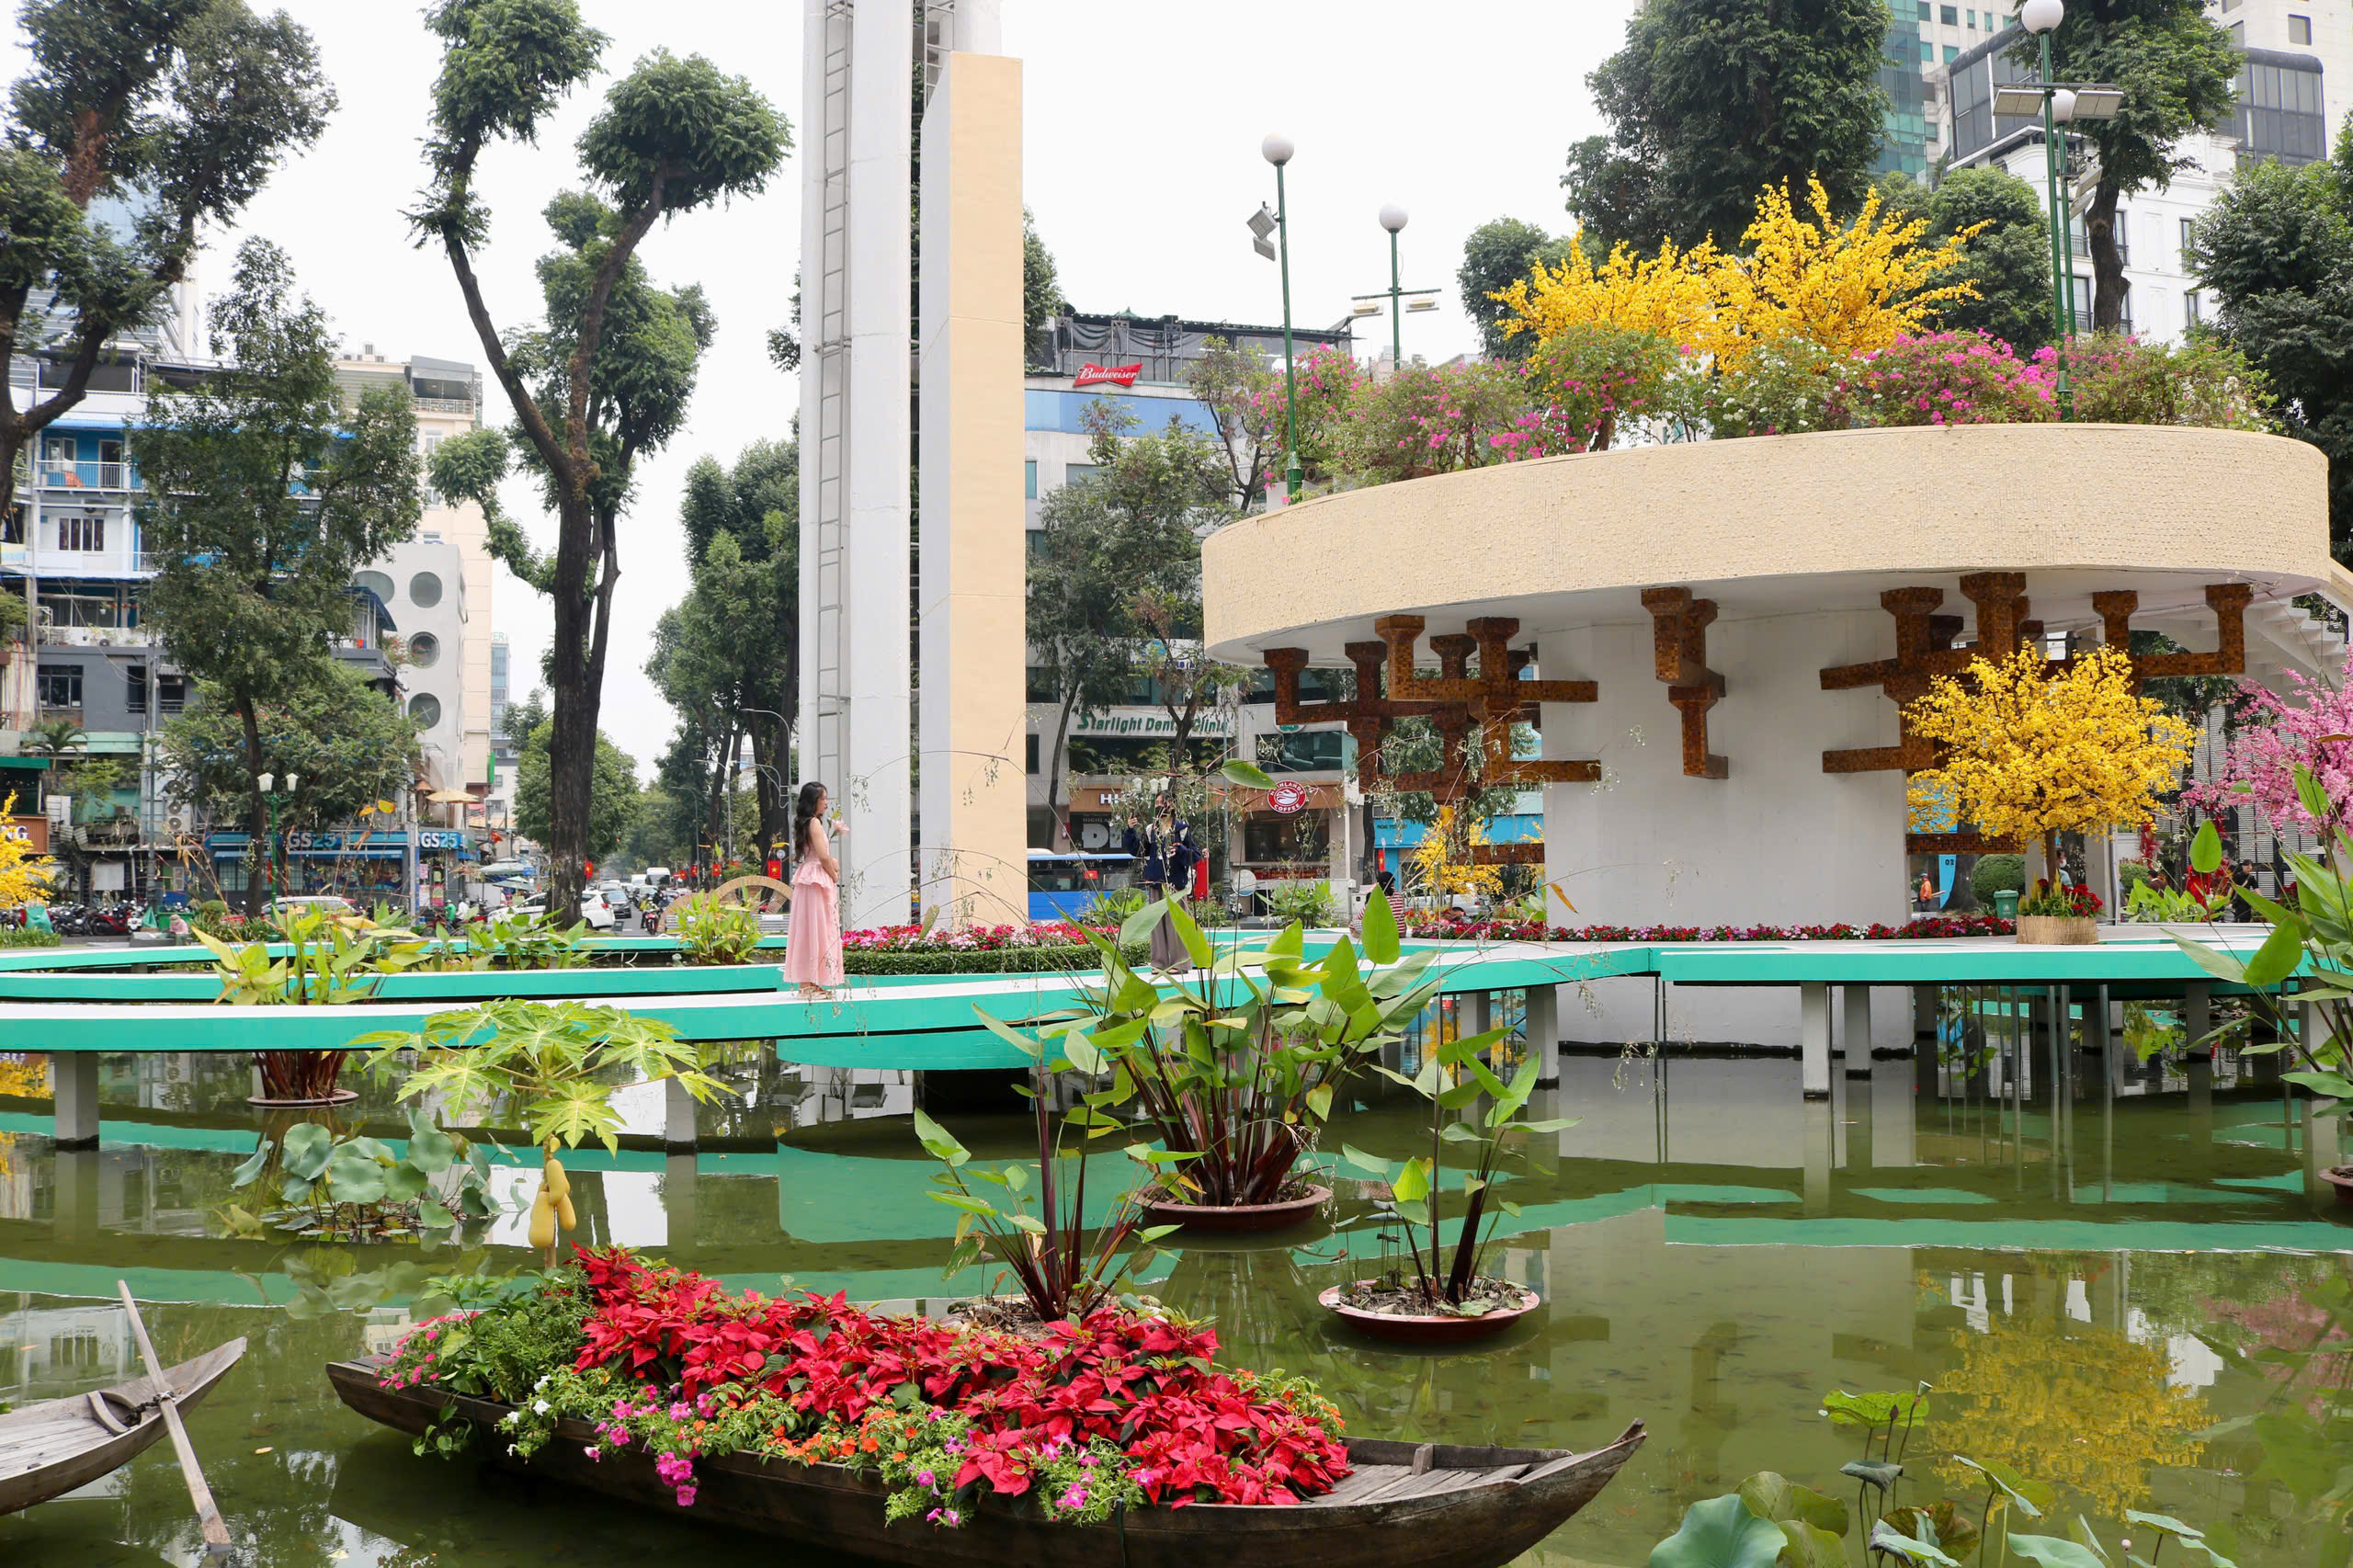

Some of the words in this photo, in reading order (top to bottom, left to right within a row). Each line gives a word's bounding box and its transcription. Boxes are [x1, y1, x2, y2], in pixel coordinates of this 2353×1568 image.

[1077, 368, 1137, 380] Budweiser
[1077, 713, 1142, 733] Starlight
[1145, 717, 1179, 732] Dent
[1269, 782, 1304, 796] HHLANDS
[1274, 803, 1301, 812] COFFEE
[289, 832, 336, 848] GS25
[421, 832, 458, 848] GS25
